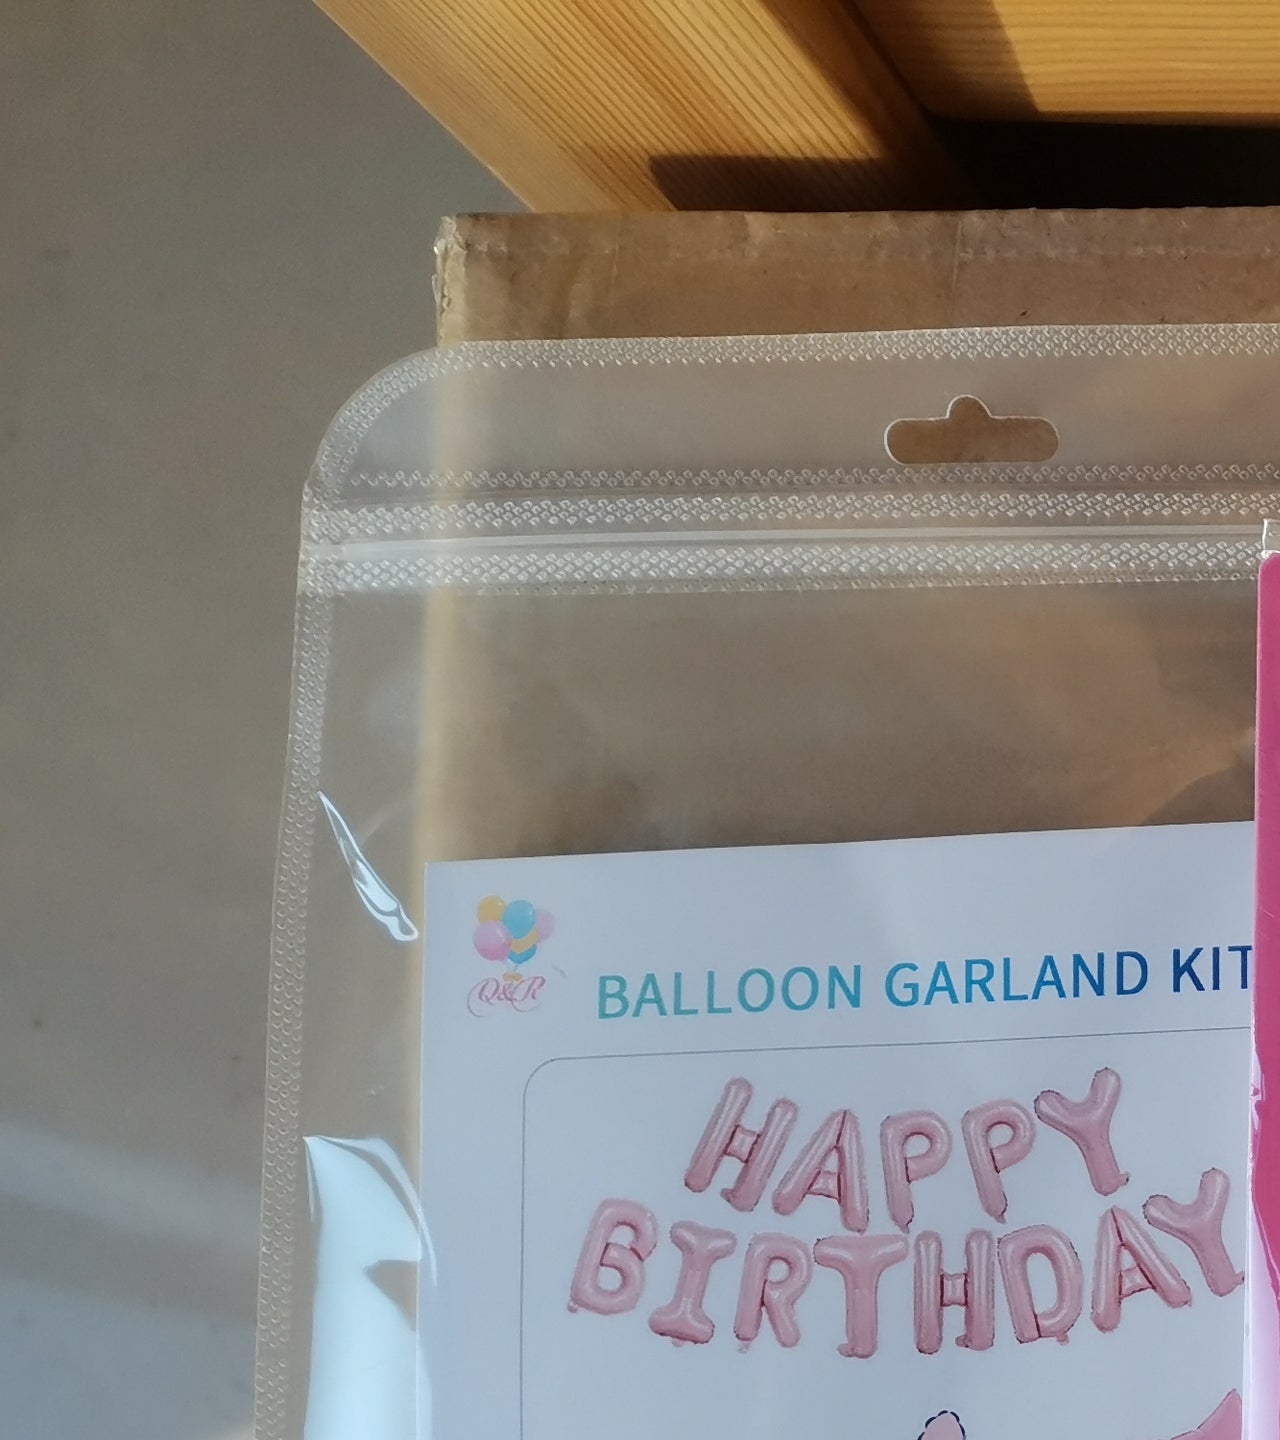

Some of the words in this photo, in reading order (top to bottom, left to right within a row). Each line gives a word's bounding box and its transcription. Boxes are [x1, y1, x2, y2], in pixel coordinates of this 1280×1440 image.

[598, 963, 863, 1021] BALLOON
[885, 950, 1149, 1010] GARLAND
[1172, 944, 1253, 994] KIT
[684, 1066, 1130, 1235] HAPPY
[566, 1166, 1246, 1359] BIRTHDAY
